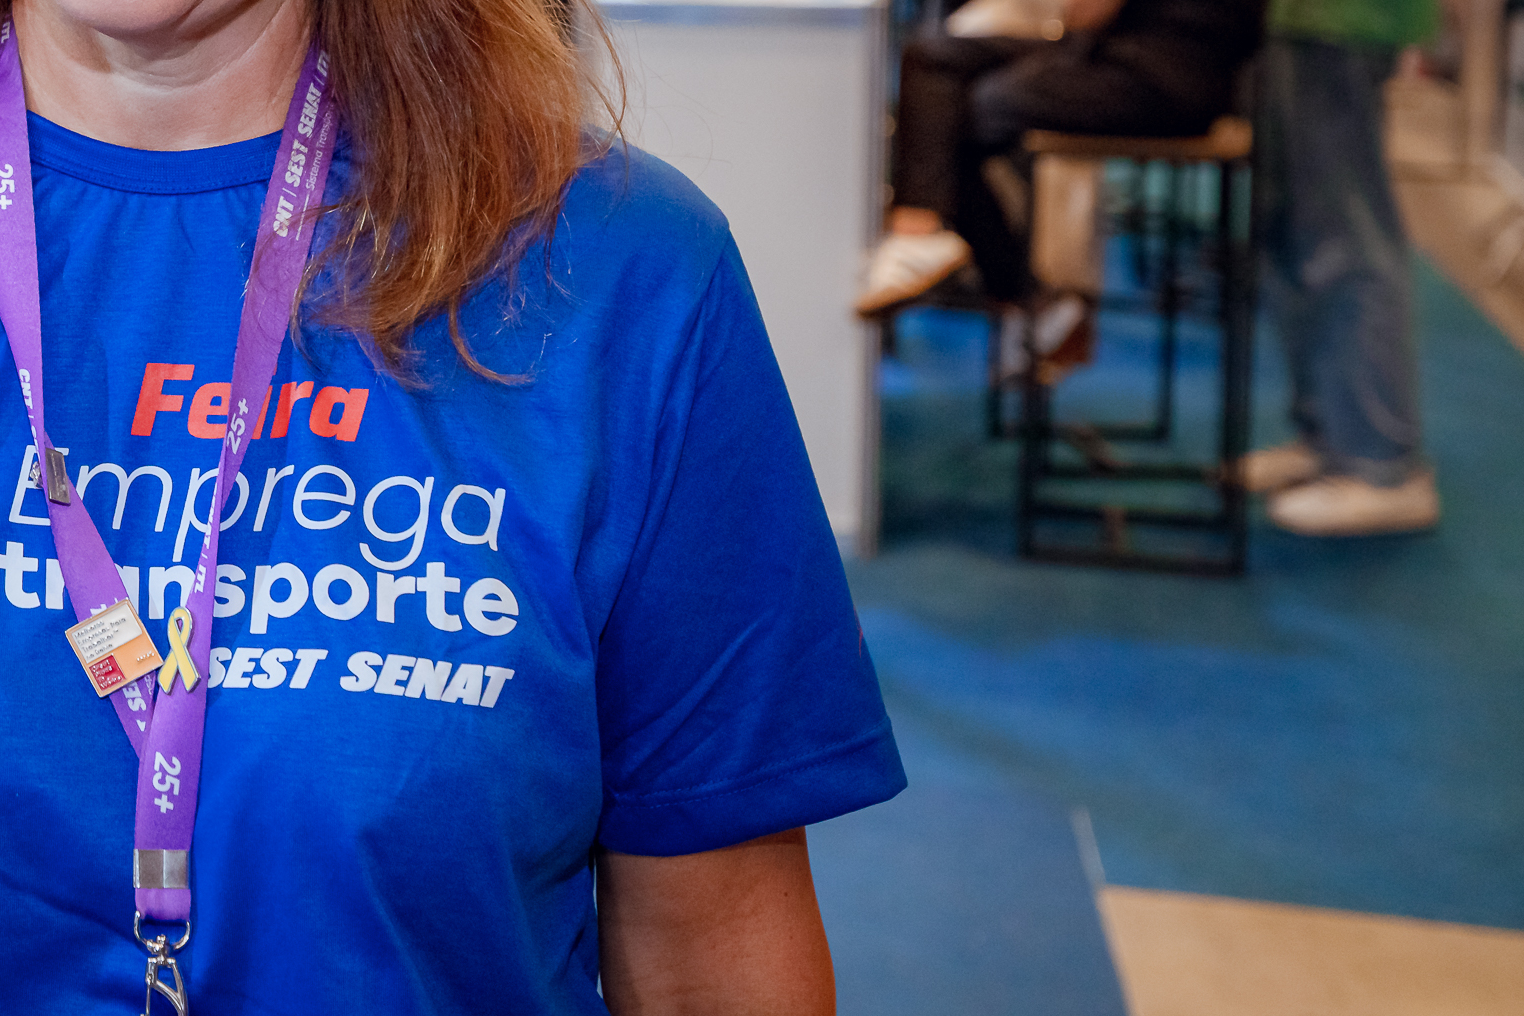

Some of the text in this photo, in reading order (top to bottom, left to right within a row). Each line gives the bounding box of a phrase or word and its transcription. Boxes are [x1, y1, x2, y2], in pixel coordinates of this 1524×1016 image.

[273, 195, 294, 237] CNT
[285, 138, 308, 187] SEST
[298, 82, 322, 138] SENAT
[305, 149, 324, 191] Sistema
[227, 398, 249, 455] 25+
[8, 445, 507, 571] Emprega
[209, 647, 328, 689] SEST
[340, 651, 515, 708] SENAT
[152, 751, 181, 814] 25+
